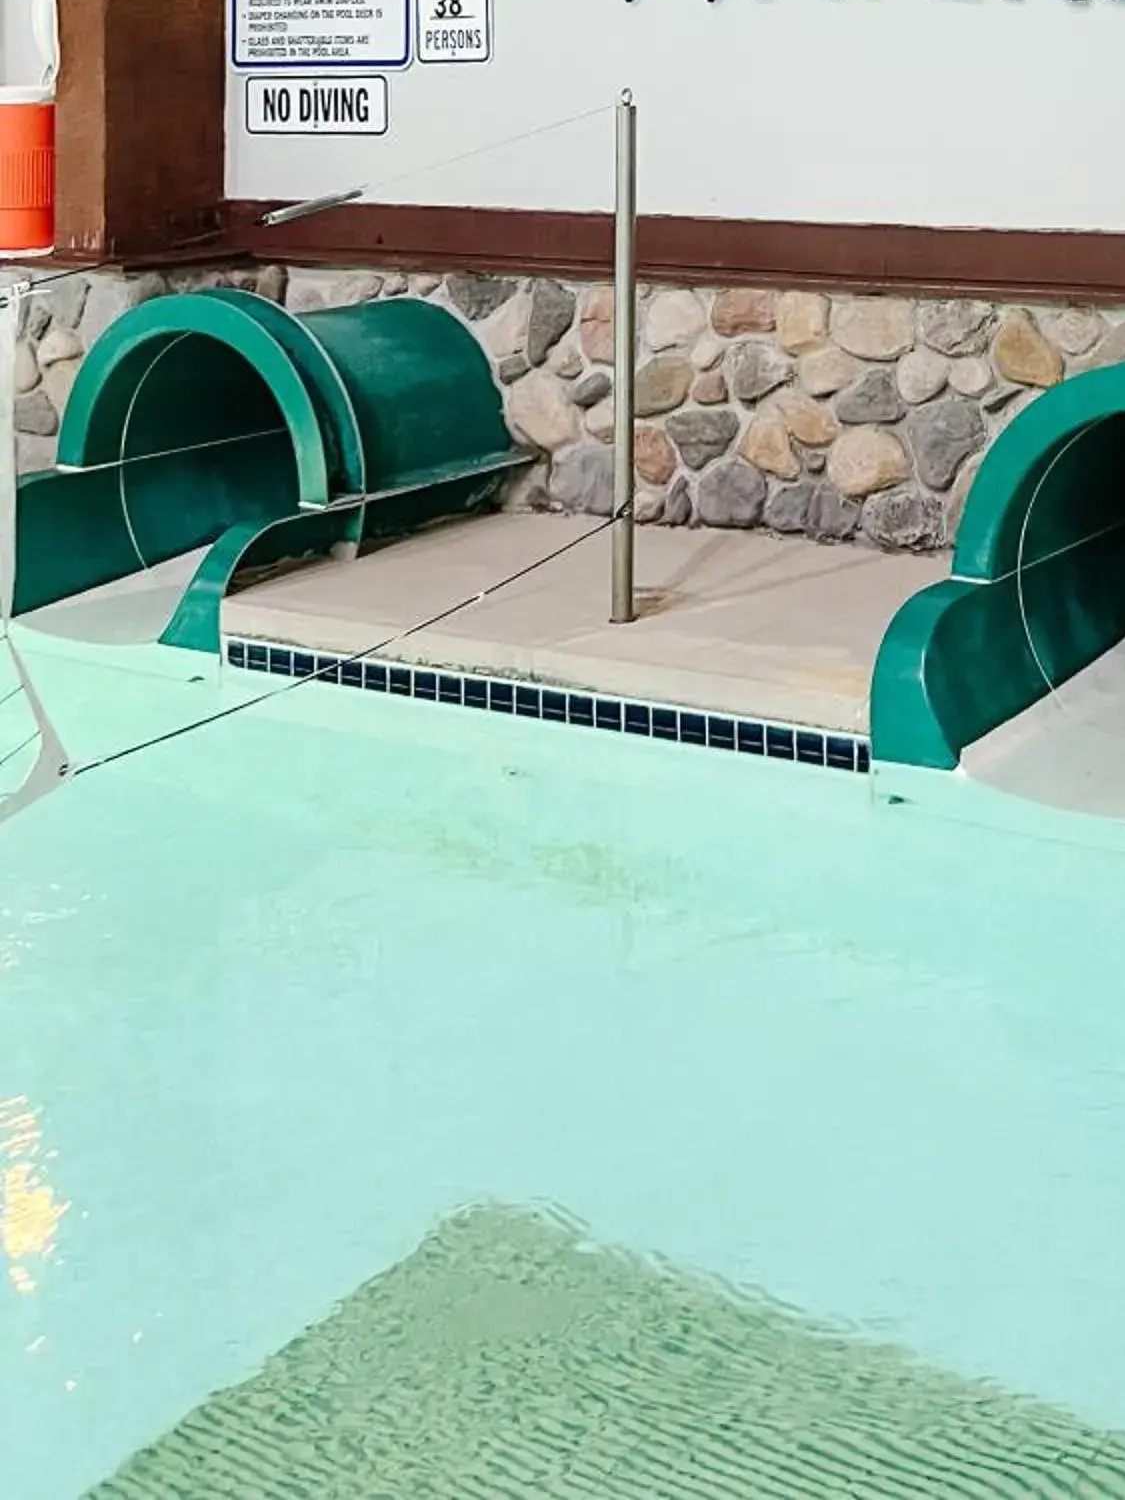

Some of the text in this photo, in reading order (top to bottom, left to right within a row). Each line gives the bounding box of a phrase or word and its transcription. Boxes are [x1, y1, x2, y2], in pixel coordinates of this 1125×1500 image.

[425, 30, 482, 51] PERSONS
[263, 88, 369, 123] NO DIVING
